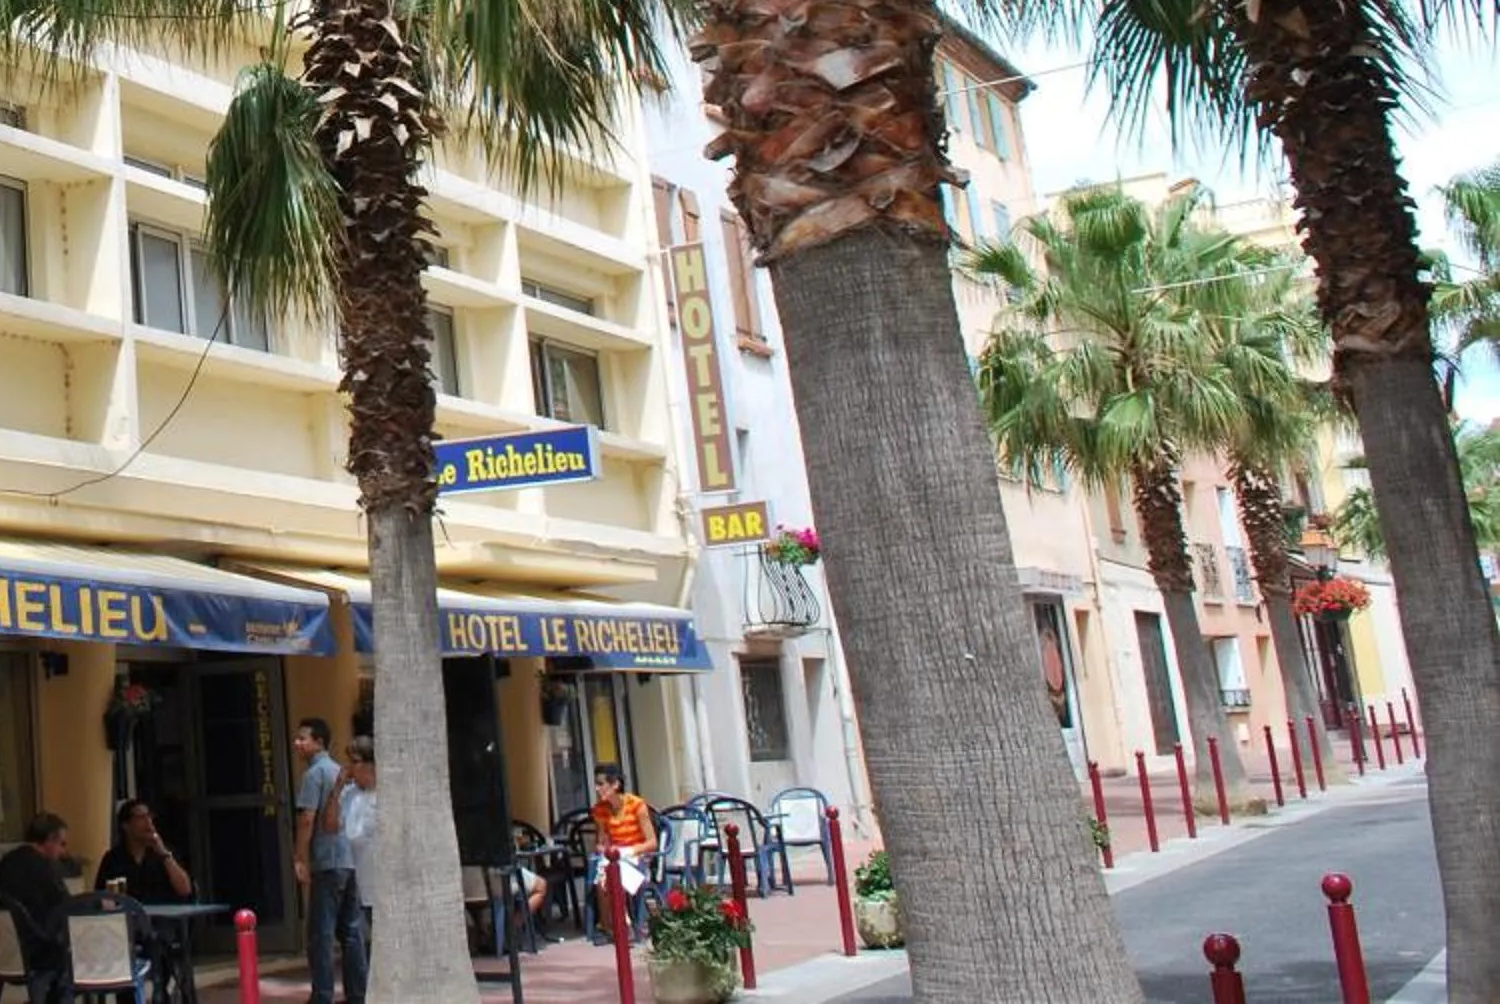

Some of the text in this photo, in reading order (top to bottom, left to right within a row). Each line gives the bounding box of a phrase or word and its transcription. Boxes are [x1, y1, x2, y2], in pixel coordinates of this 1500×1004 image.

[674, 249, 727, 487] HOTEL
[437, 443, 586, 485] e Richelieu
[708, 510, 765, 542] BAR
[448, 612, 680, 654] HOTEL LE RICHELIEU
